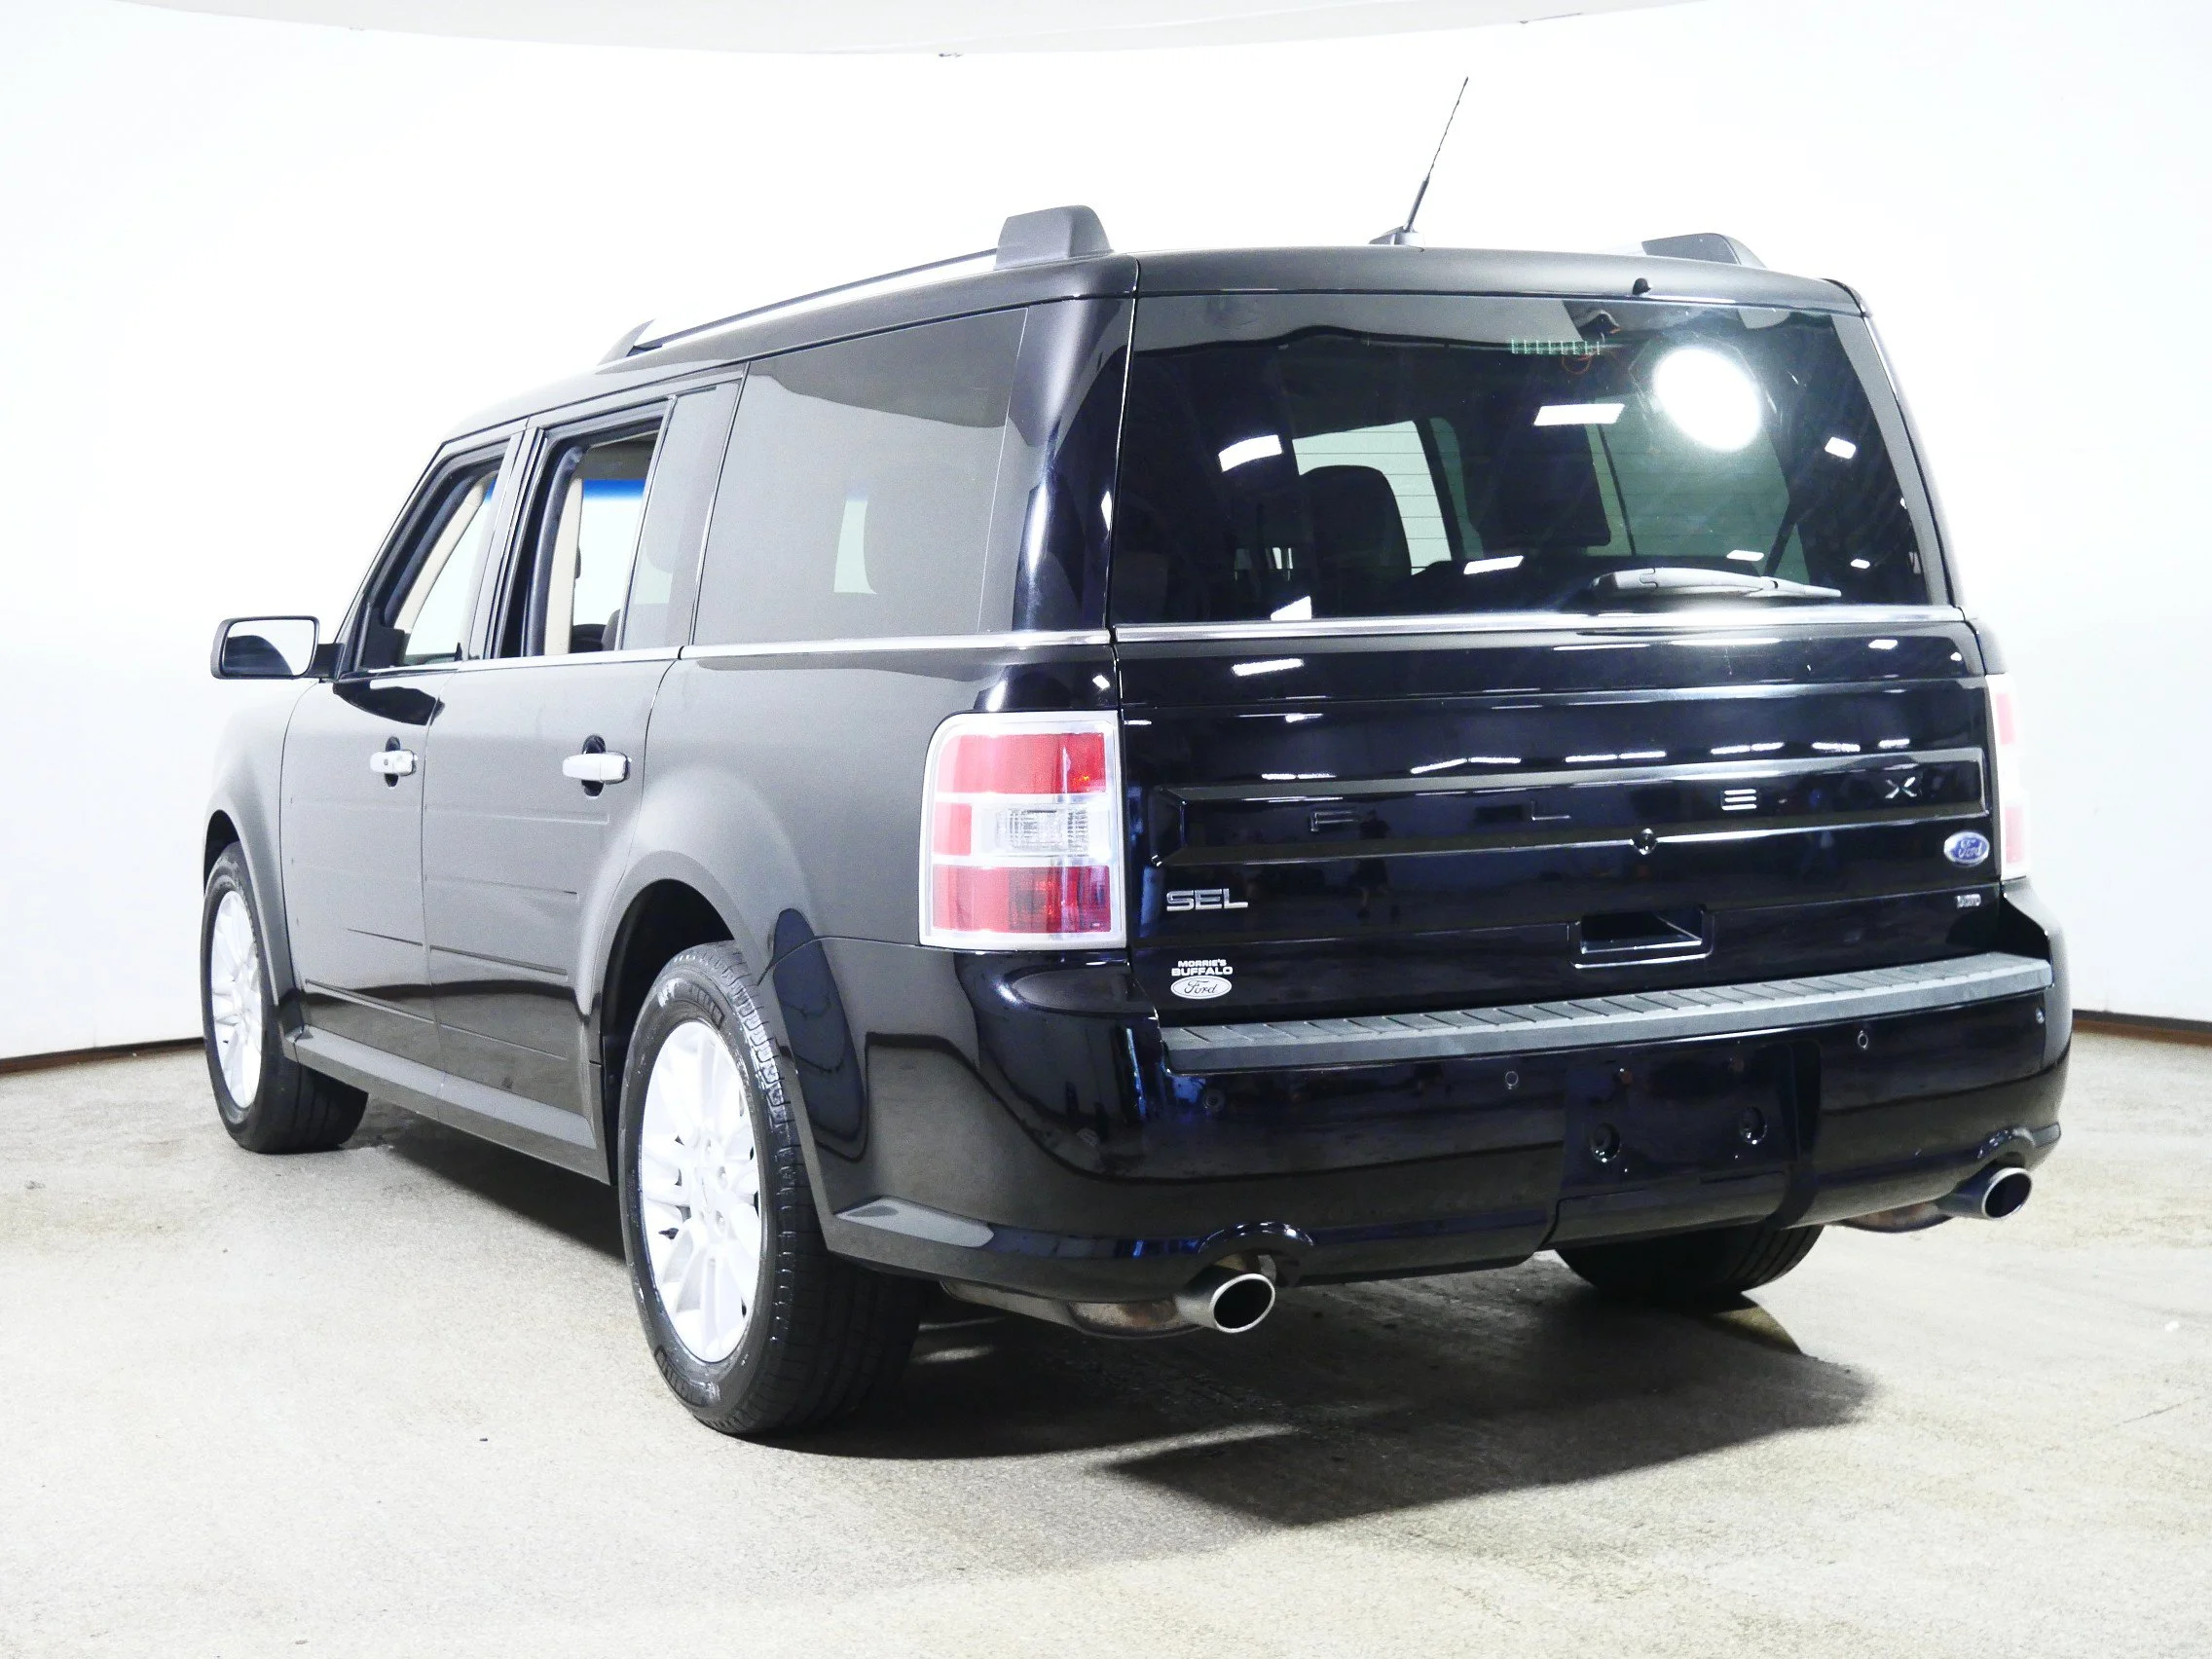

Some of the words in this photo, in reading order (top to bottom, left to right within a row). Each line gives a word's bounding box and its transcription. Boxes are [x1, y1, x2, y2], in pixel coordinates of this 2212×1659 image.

[1958, 837, 1983, 859] Ford
[1166, 888, 1249, 912] SEL
[1177, 958, 1227, 968] MORRIE'S
[1171, 967, 1234, 977] BUFFALO
[1184, 979, 1218, 995] Ford
